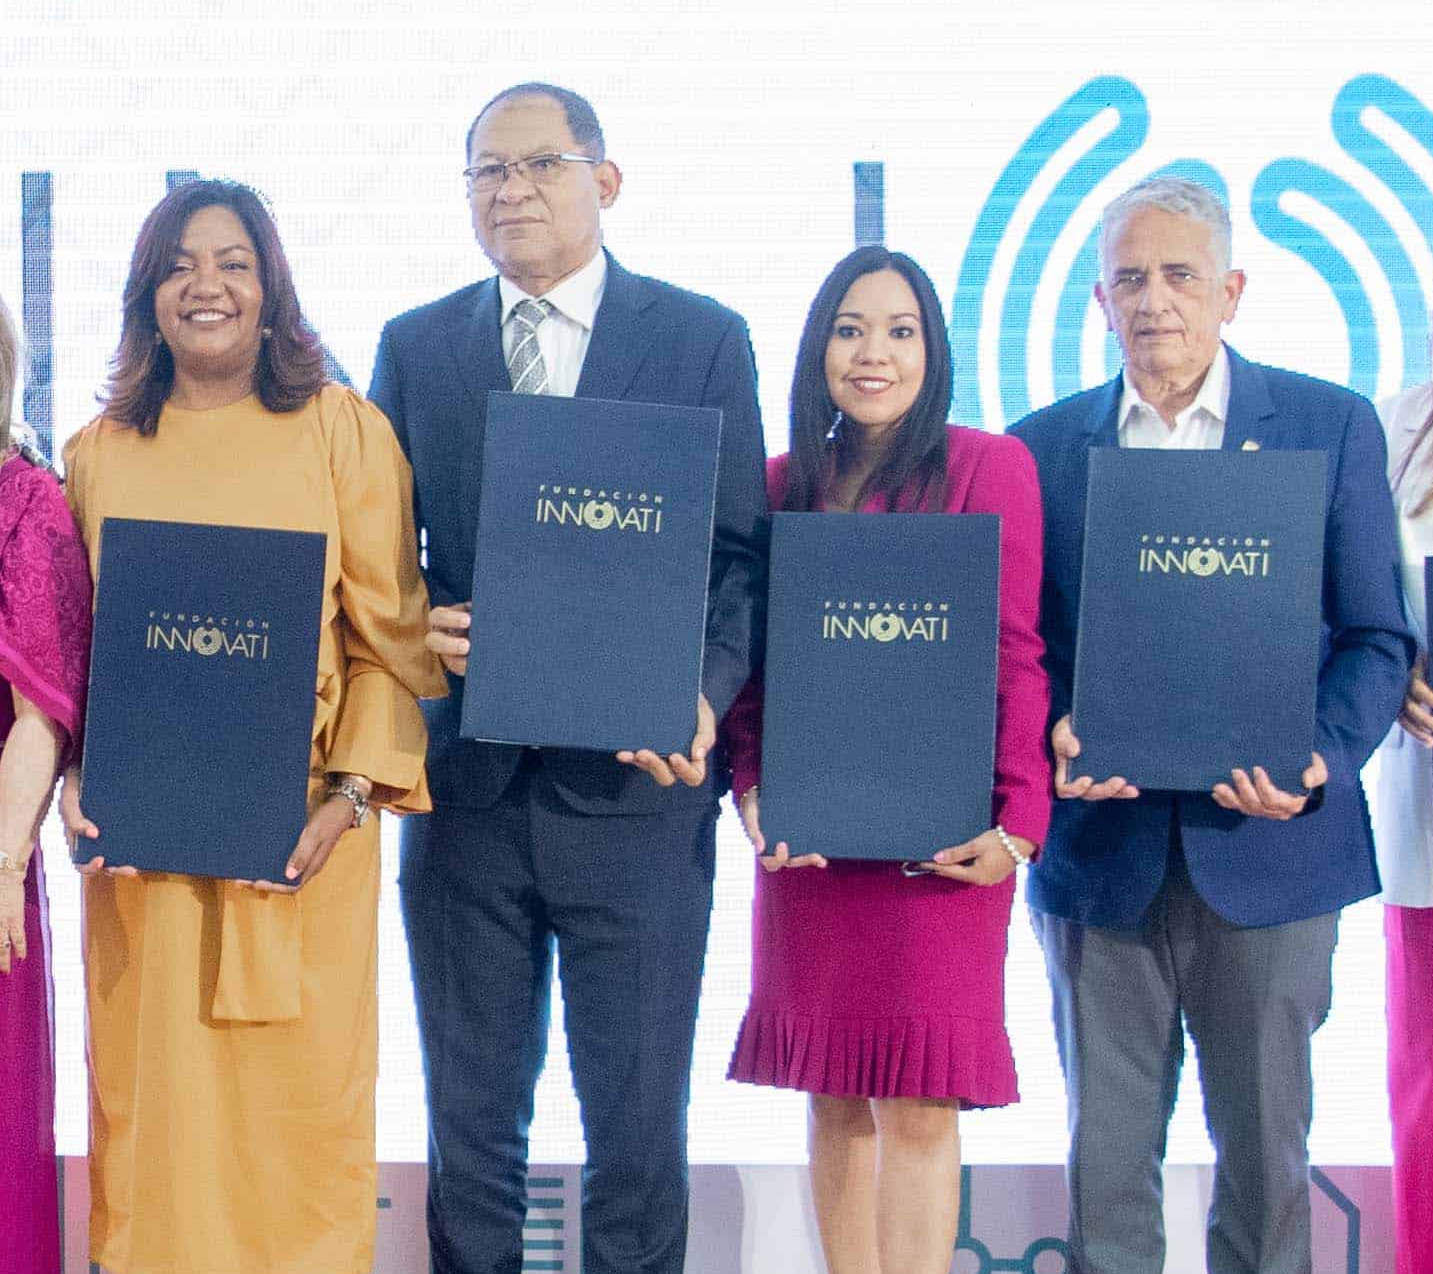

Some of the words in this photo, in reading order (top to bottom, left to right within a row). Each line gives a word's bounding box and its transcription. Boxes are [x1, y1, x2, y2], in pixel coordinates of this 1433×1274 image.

[536, 498, 662, 534] INNOVATI
[1139, 546, 1269, 577] INNOVATI
[146, 624, 269, 660] INNOVATI
[822, 612, 948, 642] INNOVATI
